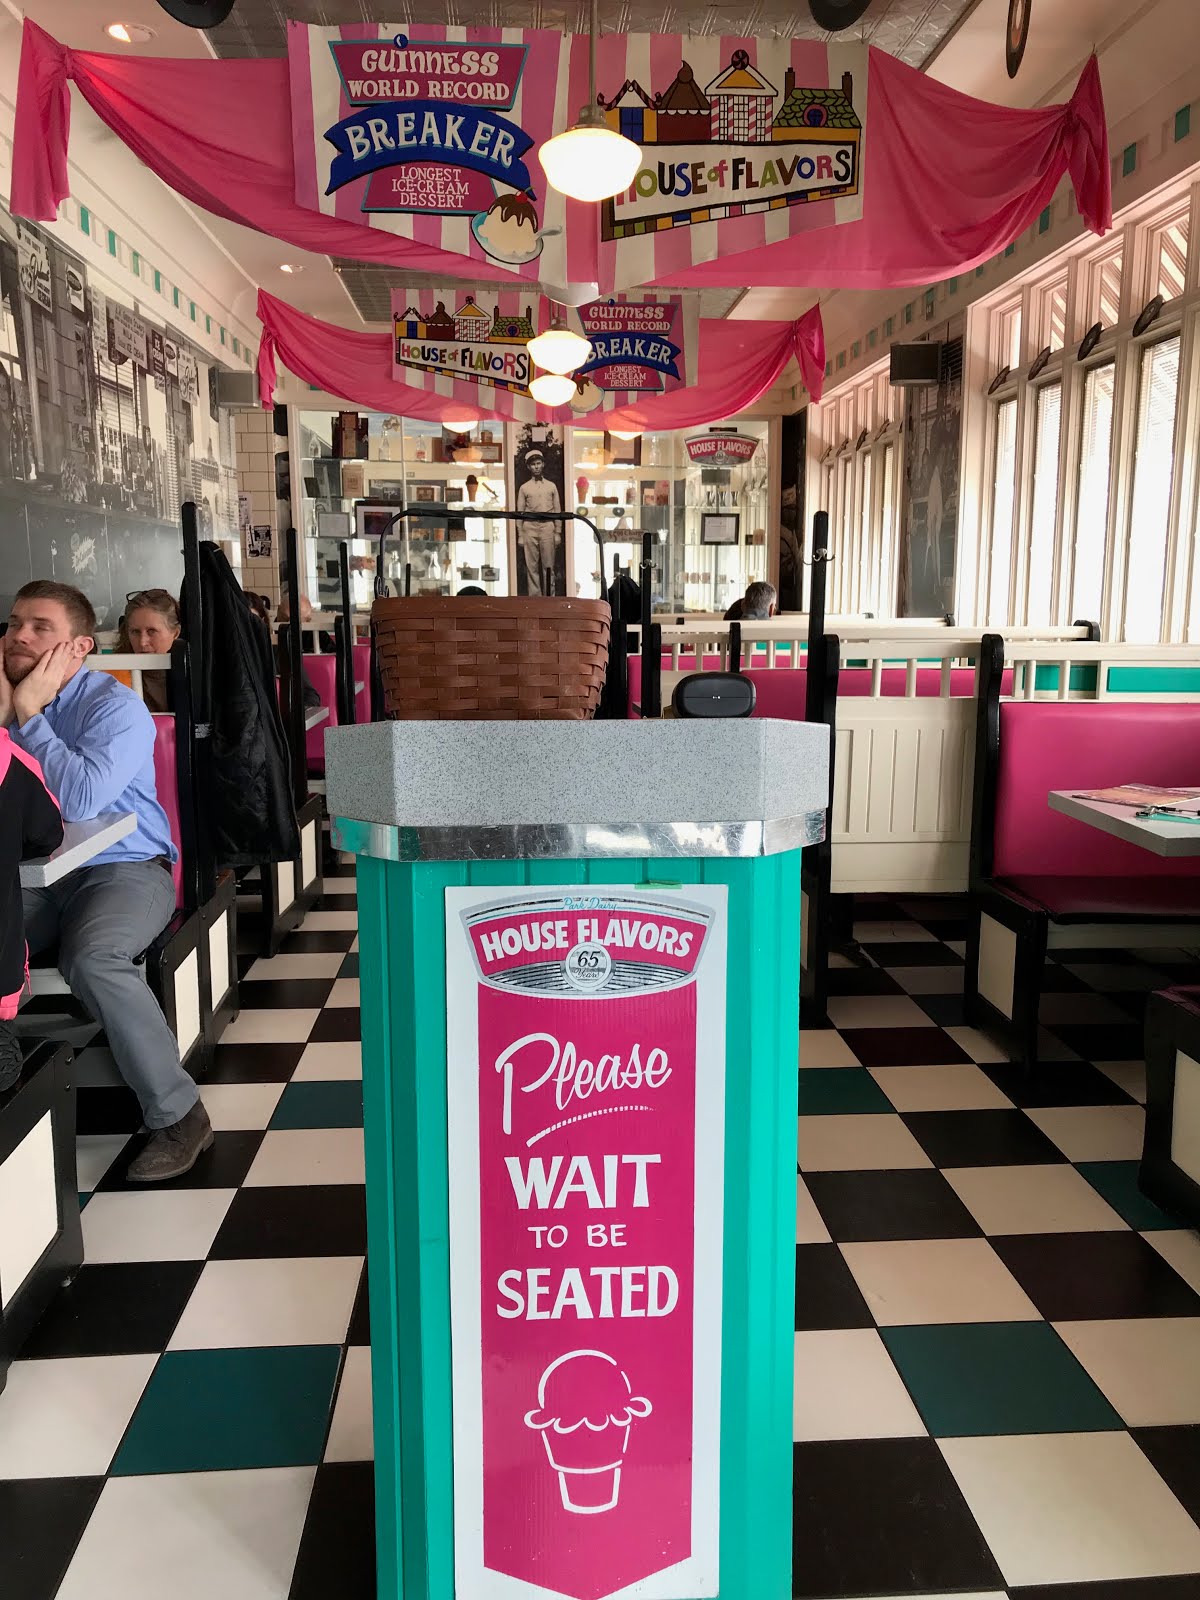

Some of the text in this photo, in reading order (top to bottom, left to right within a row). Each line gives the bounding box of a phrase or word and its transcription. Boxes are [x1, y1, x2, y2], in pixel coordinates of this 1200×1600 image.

[361, 49, 500, 77] GUINNESS
[347, 79, 510, 100] WORLD RECORD
[344, 111, 516, 169] BREAKER
[400, 166, 462, 182] LONGEST
[707, 159, 729, 188] of
[731, 149, 851, 191] FLAVORS
[391, 179, 470, 195] ICE-CREAM
[399, 193, 465, 208] DESSERT
[584, 321, 671, 331] WORLD RECORD
[401, 342, 528, 381] HOUSE of FLAVORS
[609, 366, 642, 374] LONGEST
[690, 441, 752, 455] HOUSE FLAVORS
[587, 896, 618, 917] Dairy
[479, 918, 694, 963] HOUSE FLAVORS
[577, 950, 601, 969] 65
[495, 1032, 673, 1135] Please
[504, 1154, 662, 1210] WAIT
[527, 1224, 628, 1249] TO BE
[496, 1265, 680, 1321] SEATED
